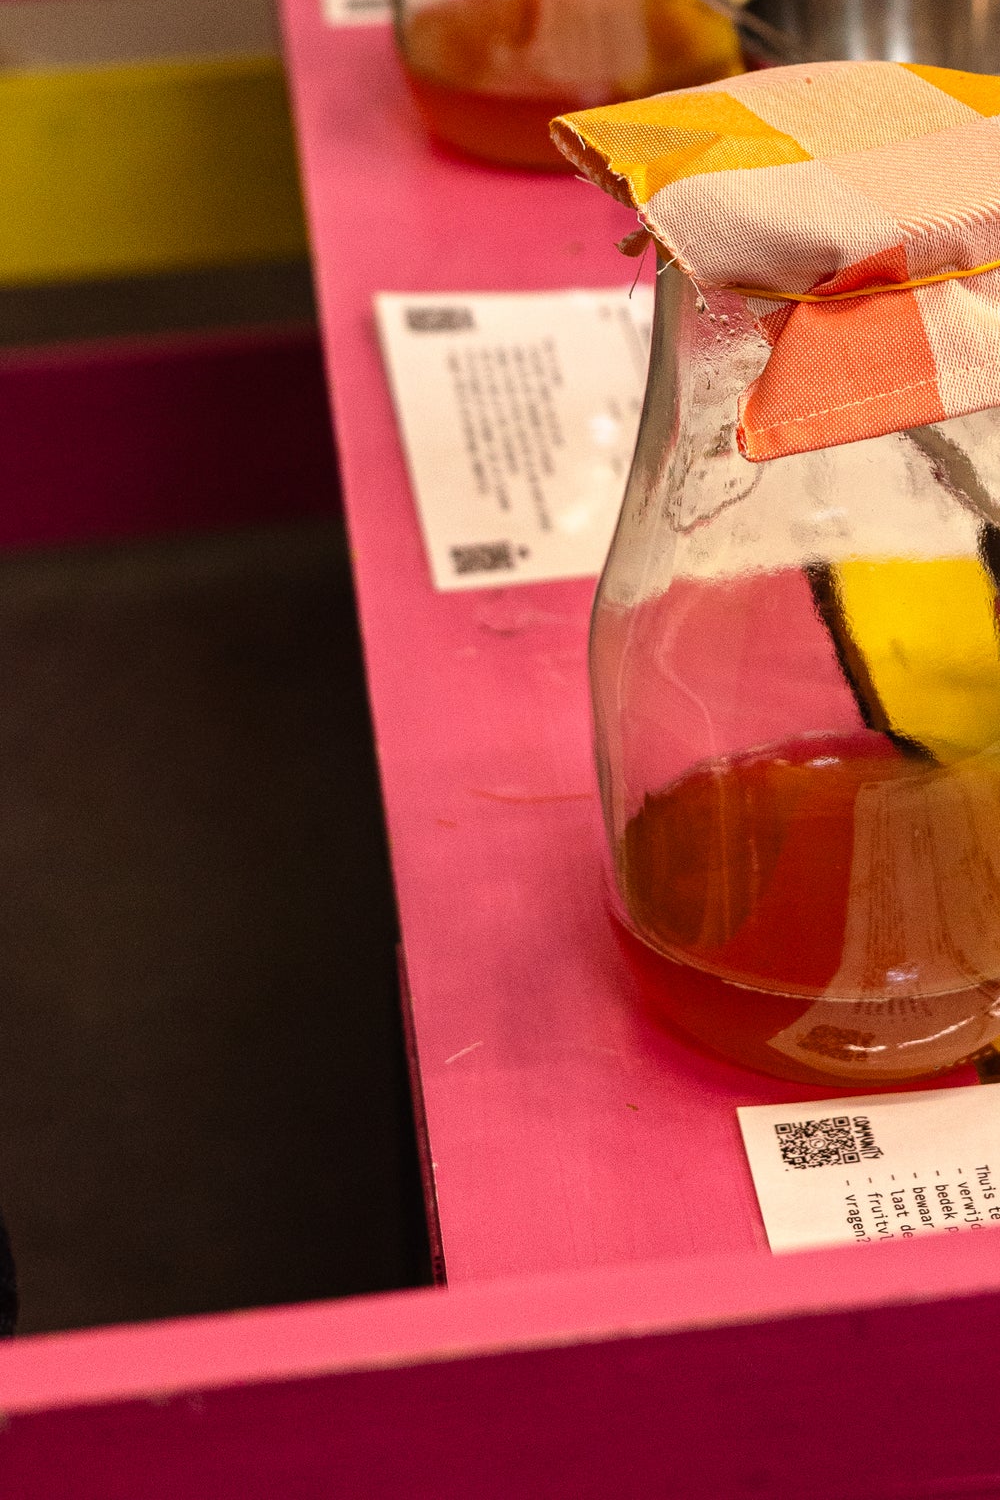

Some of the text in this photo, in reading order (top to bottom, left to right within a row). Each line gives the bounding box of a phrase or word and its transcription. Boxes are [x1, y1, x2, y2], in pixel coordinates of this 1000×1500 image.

[852, 1115, 884, 1160] COMMUNITY
[935, 1183, 958, 1220] bedek
[974, 1164, 997, 1200] Thuis
[844, 1193, 872, 1243] vragen?
[867, 1191, 895, 1241] fruitvl
[890, 1188, 916, 1239] laat de
[912, 1186, 935, 1229] bewaar
